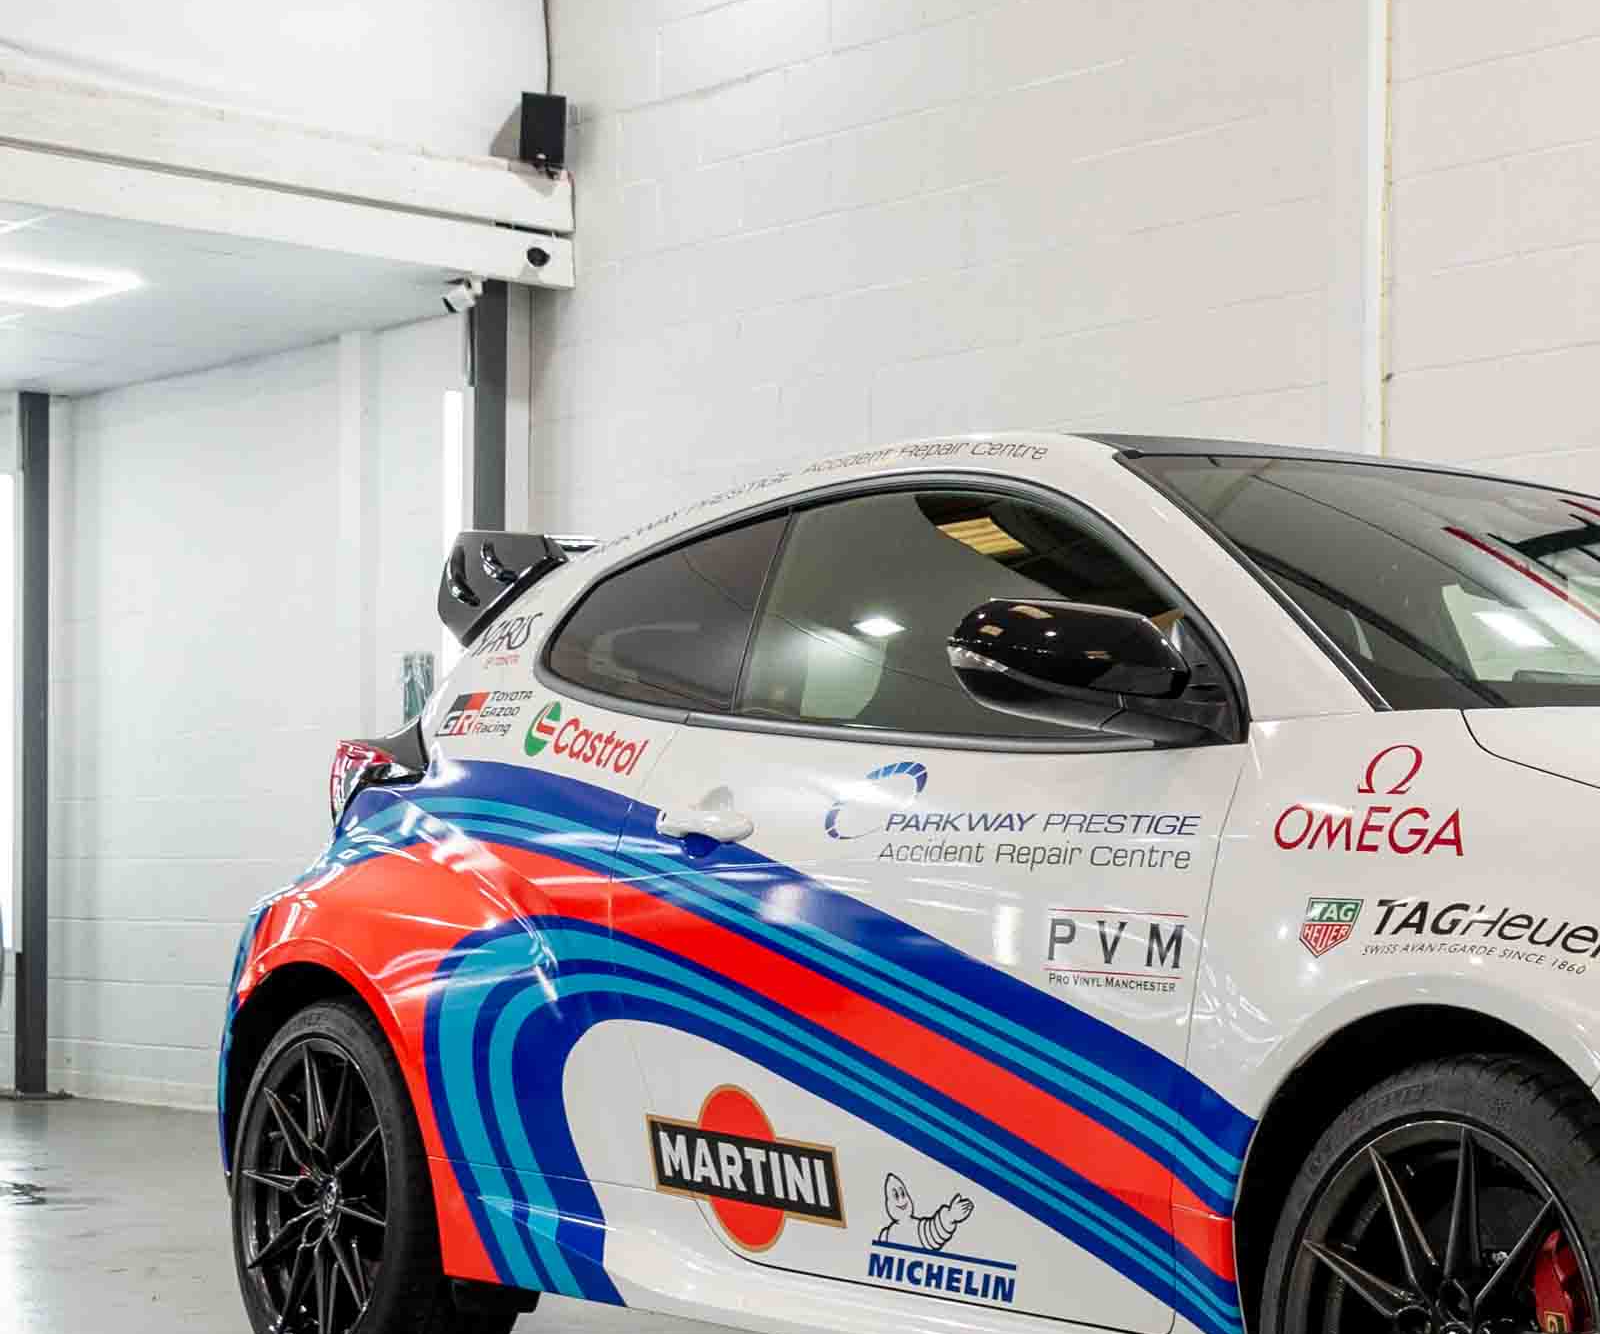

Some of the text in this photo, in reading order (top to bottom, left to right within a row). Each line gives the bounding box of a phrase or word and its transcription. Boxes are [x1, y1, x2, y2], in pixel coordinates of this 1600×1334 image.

[897, 442, 969, 460] Repair
[970, 442, 1048, 460] Centre
[491, 691, 534, 702] TOYOTA
[480, 707, 521, 718] GAZOO
[472, 723, 512, 737] Racing
[553, 717, 649, 776] Castrol
[885, 812, 1201, 836] PARKWAY PRESTIGE
[1273, 803, 1464, 857] OMEGA
[879, 839, 1191, 871] Accident Repair Centre
[1311, 902, 1357, 922] TAG
[1302, 924, 1351, 950] HEUER
[1361, 943, 1398, 956] SWISS
[1499, 948, 1546, 965] SINCE
[1551, 958, 1587, 975] 1860
[657, 1129, 832, 1208] MARTINI
[867, 1252, 1016, 1304] MICHELIN
